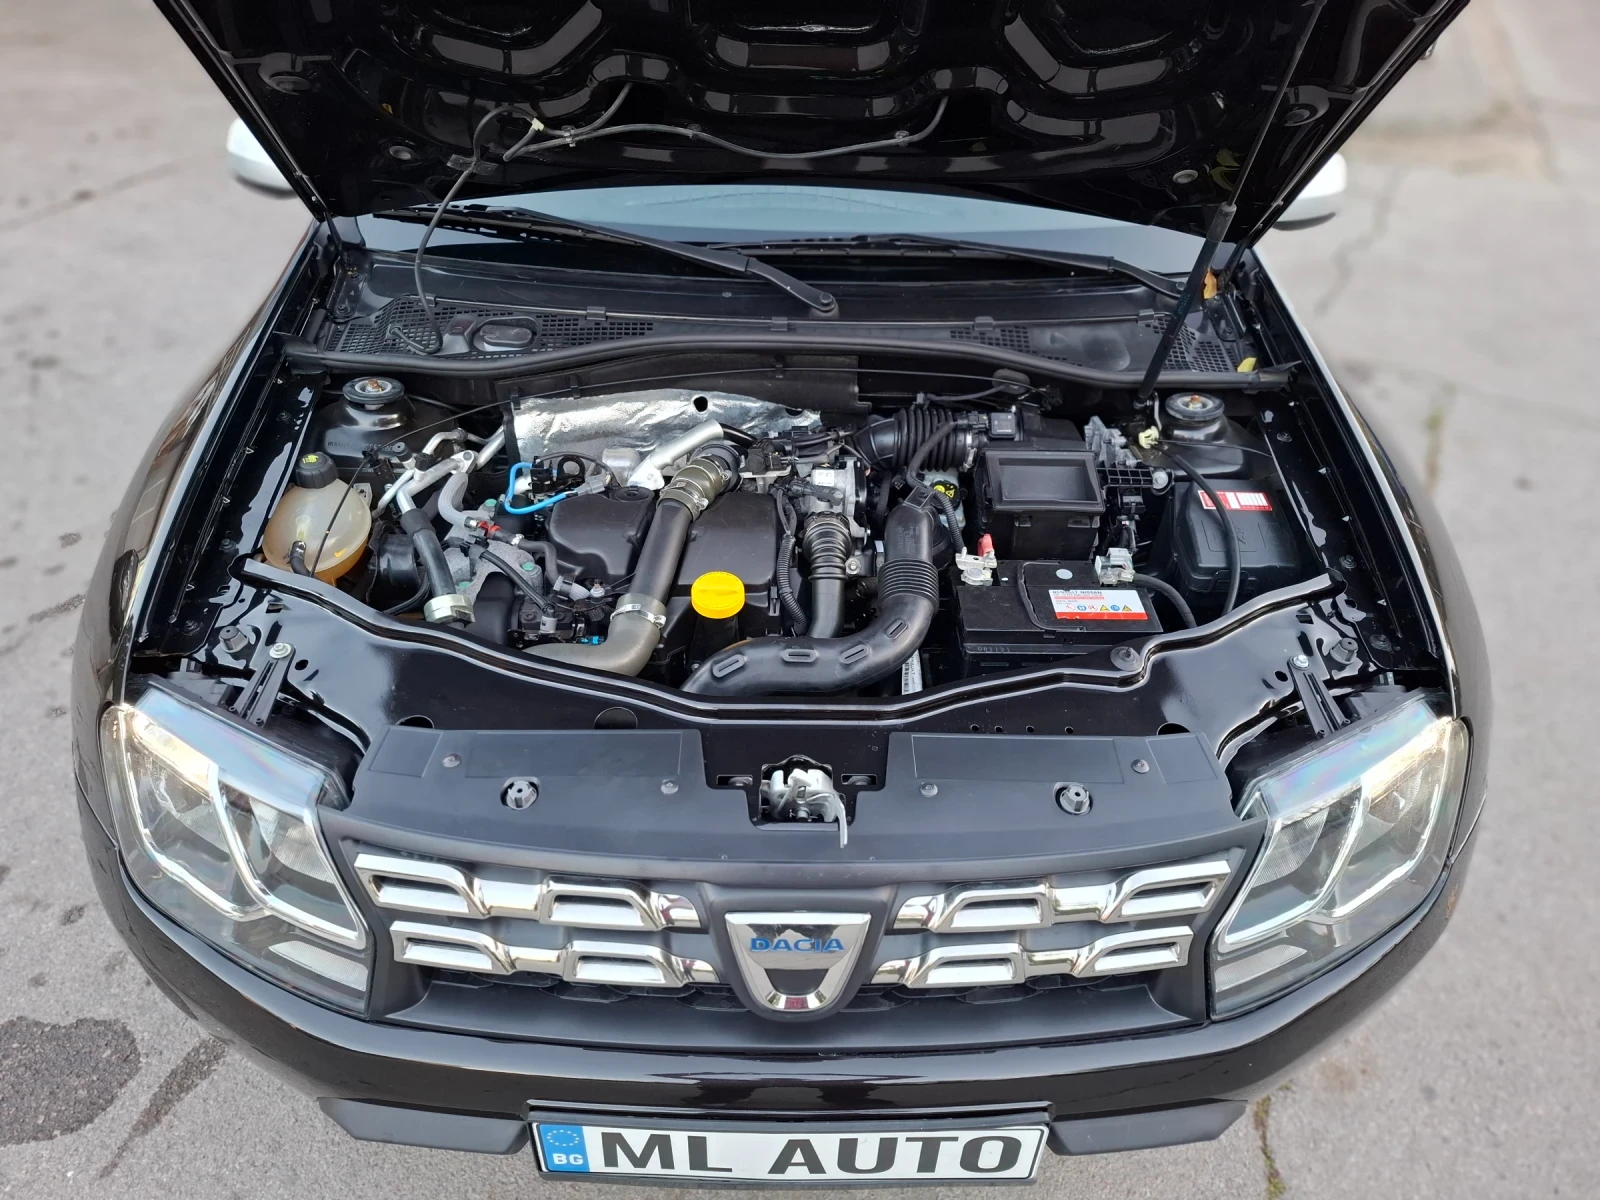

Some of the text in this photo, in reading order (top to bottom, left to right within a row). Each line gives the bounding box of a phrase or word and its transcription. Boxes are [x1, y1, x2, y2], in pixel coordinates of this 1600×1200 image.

[750, 938, 844, 952] DACIA
[552, 1153, 584, 1165] BG
[601, 1132, 1022, 1175] ML AUTO
